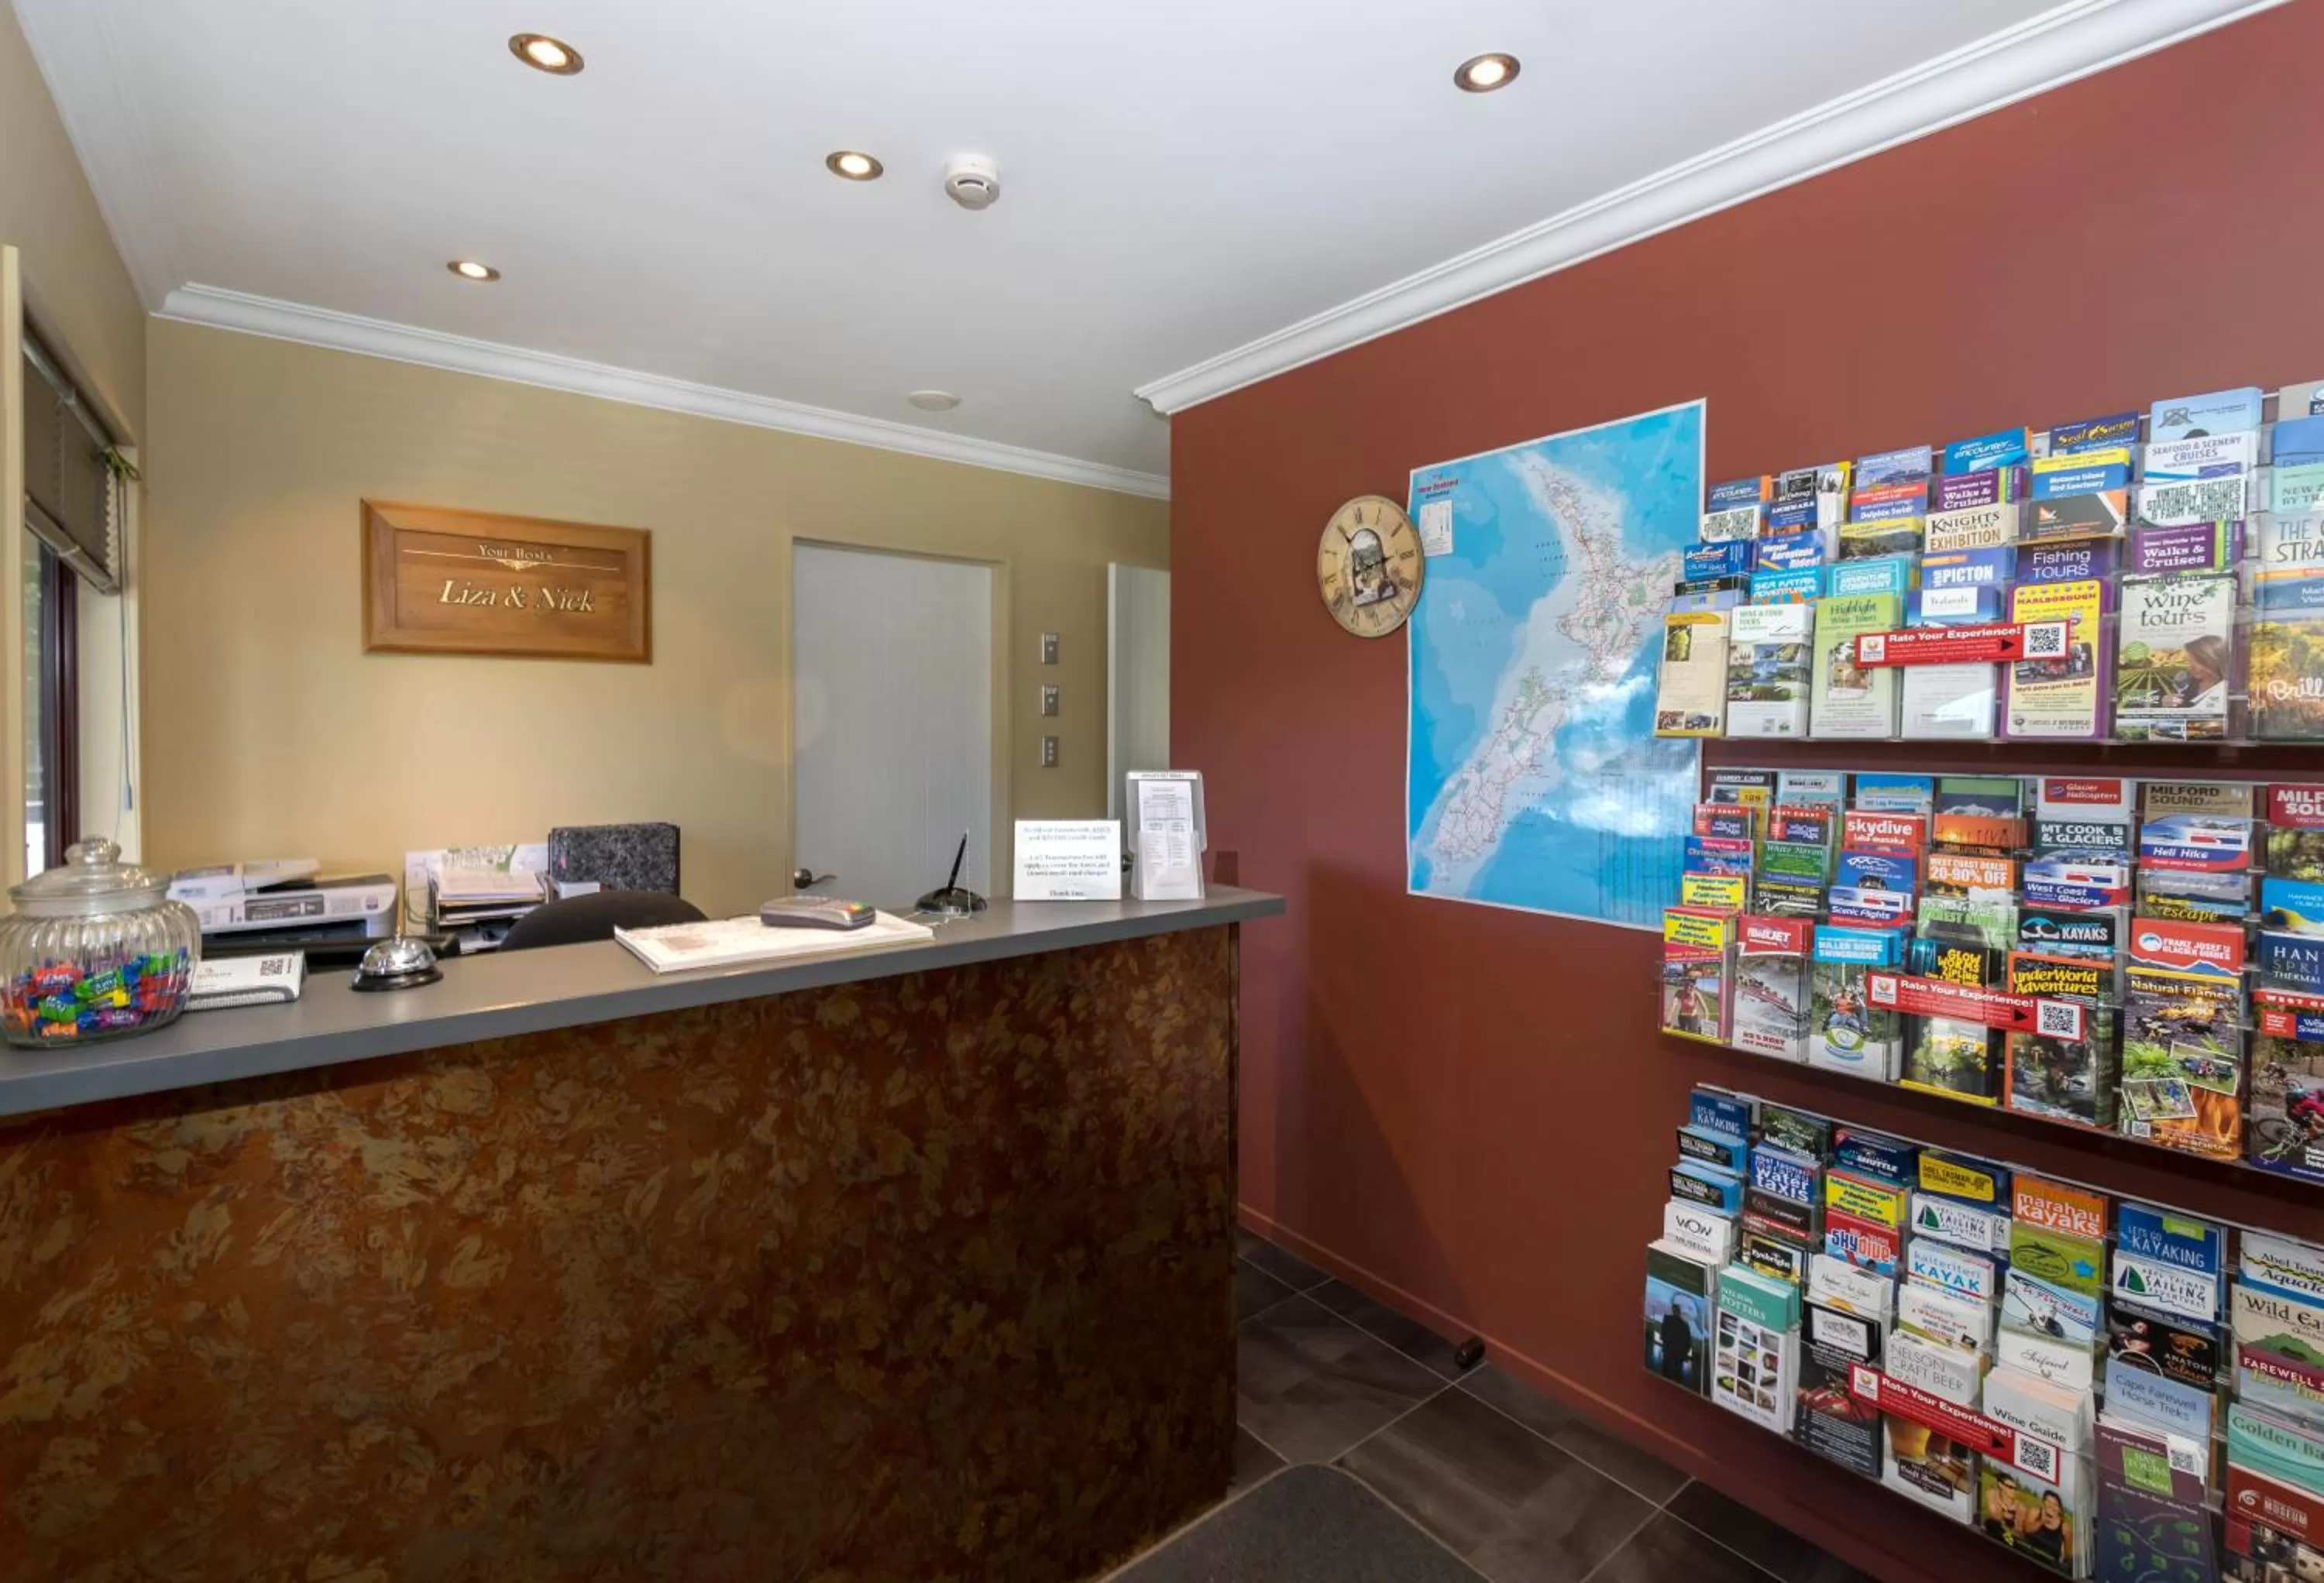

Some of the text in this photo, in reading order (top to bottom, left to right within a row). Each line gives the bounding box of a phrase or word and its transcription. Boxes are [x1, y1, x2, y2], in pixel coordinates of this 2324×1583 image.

[2151, 443, 2192, 457] SEAFOOD
[2202, 436, 2242, 448] SCENERY
[2173, 448, 2218, 462] CRUISES
[2049, 480, 2105, 492] Bird Sanctuary
[2156, 484, 2192, 500] VINTAGE
[1944, 489, 1979, 500] Walks
[1944, 496, 1992, 510] Cruises
[1931, 511, 2000, 534] KNIGHTS
[2278, 519, 2313, 541] THE
[1930, 528, 2001, 551] EXHIBITION
[478, 544, 552, 561] Your Hosts
[2033, 550, 2091, 564] Fishing
[2144, 547, 2190, 558] Walks
[2144, 555, 2206, 568] Cruises
[1941, 565, 1994, 584] PICTON
[2032, 564, 2089, 579] TOURS
[439, 579, 596, 613] Liza & Nick
[2140, 609, 2207, 627] tours
[1889, 627, 2021, 642] Rate Your Experience!
[2066, 783, 2099, 792] Glacier
[2066, 791, 2118, 800] Helicopters
[2150, 785, 2220, 798] MILFORD
[2149, 795, 2205, 806] SOUND
[1847, 819, 1913, 836] skydive
[2041, 824, 2106, 835] MT COOK
[2041, 833, 2124, 845] & GLACIERS
[2153, 846, 2209, 859] Heli Hike
[1930, 857, 1951, 867] WEST
[1953, 859, 1978, 868] COAST
[1930, 867, 2009, 885] 20-90% OFF
[2027, 881, 2088, 896] West Coast
[2058, 895, 2100, 905] Glaciers
[1831, 905, 1891, 920] Scenic Flights
[2162, 906, 2219, 922] escape
[2061, 927, 2108, 941] KAYAKS
[2162, 938, 2223, 952] FRANZ JOSEF
[2162, 946, 2231, 960] GLACIER GUIDES
[1948, 949, 1982, 964] GLOW
[1900, 980, 2034, 1008] Rate Your Experience!
[2015, 981, 2099, 994] Adventures
[2131, 979, 2233, 1001] Natural Flames
[1756, 1166, 1810, 1190] water
[1756, 1176, 1810, 1203] taxis
[1939, 1214, 1986, 1234] SAILING
[2016, 1203, 2099, 1237] kayaks
[2150, 1231, 2162, 1241] GO
[2131, 1235, 2205, 1269] KAYAKING
[2260, 1252, 2290, 1268] Abel
[1914, 1261, 1980, 1293] KAYAK
[2169, 1276, 2206, 1292] TASMAN
[2145, 1274, 2206, 1302] SAILING
[2245, 1294, 2289, 1321] Wild
[1891, 1344, 1946, 1372] NELSON
[1890, 1358, 1964, 1391] CRAFT BEER
[2243, 1357, 2315, 1388] FAREWELL
[2116, 1375, 2197, 1412] Cape Farewell
[1882, 1377, 2012, 1438] Rate Your Experience!
[2121, 1388, 2190, 1422] Horse Treks
[1992, 1404, 2067, 1444] Wine Guide
[2231, 1416, 2324, 1461] Golden Ba
[2264, 1495, 2308, 1527] MUSEUM
